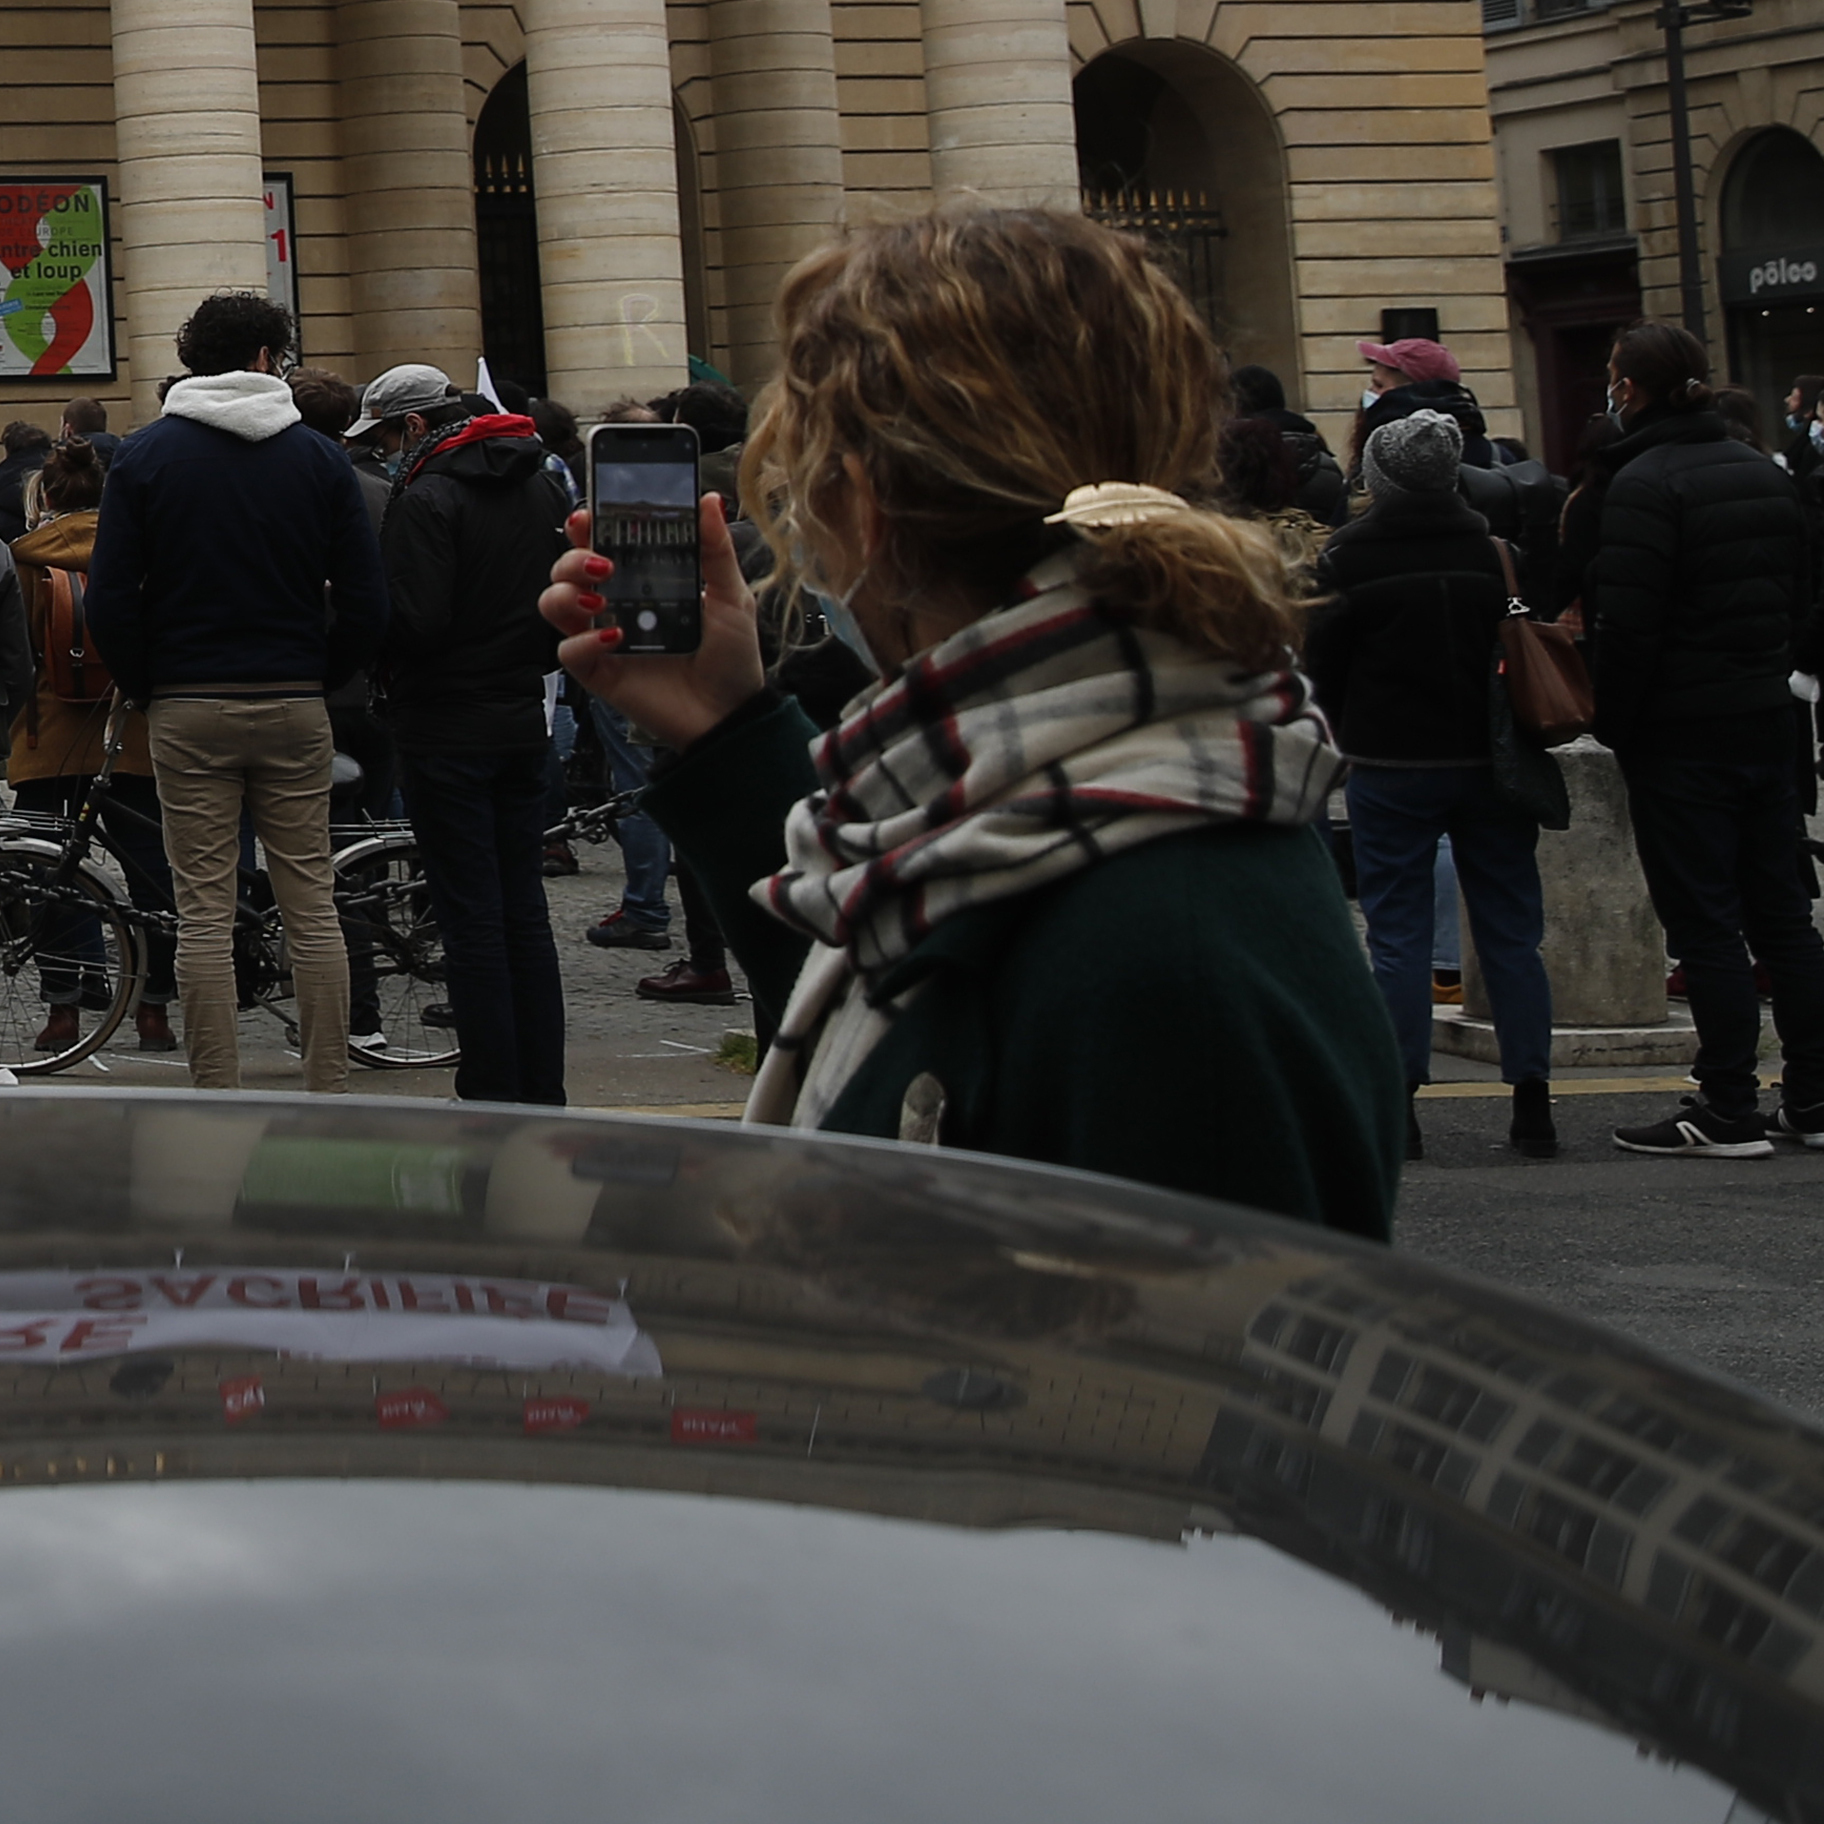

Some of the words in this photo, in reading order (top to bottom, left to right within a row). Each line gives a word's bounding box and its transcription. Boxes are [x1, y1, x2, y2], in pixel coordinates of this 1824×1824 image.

[48, 240, 103, 258] chien
[10, 264, 31, 280] et
[37, 262, 82, 282] loup
